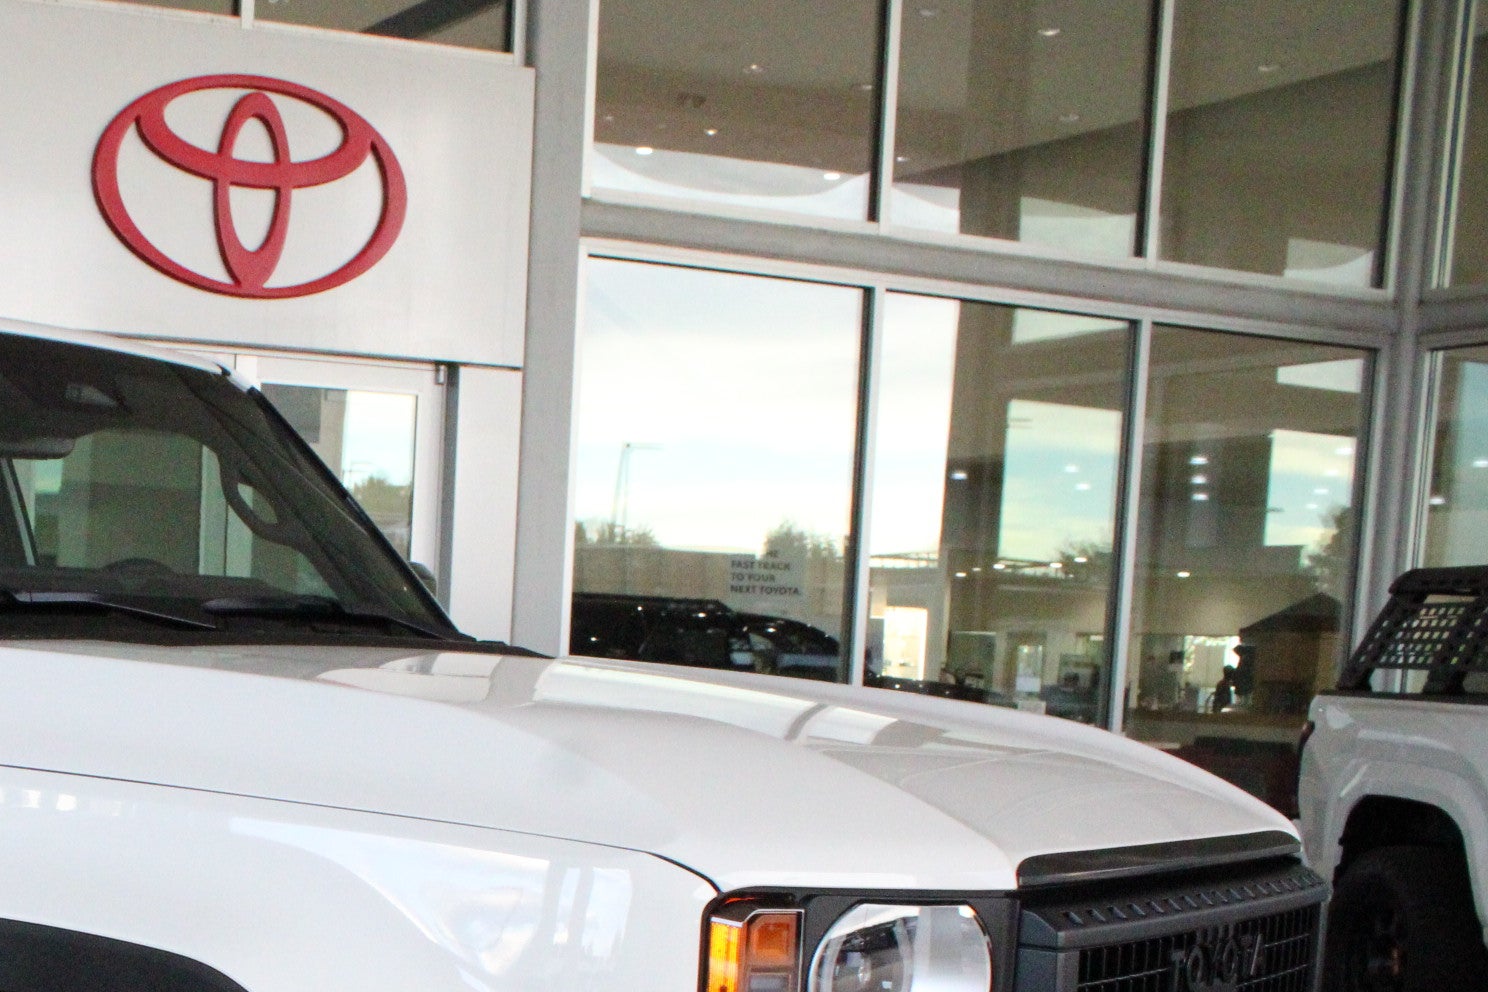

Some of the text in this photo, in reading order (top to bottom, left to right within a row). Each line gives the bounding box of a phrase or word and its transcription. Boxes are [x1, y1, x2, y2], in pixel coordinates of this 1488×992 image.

[731, 560, 791, 571] FAST TRACK
[731, 572, 776, 582] TO YOUR
[730, 585, 757, 594] NEXT
